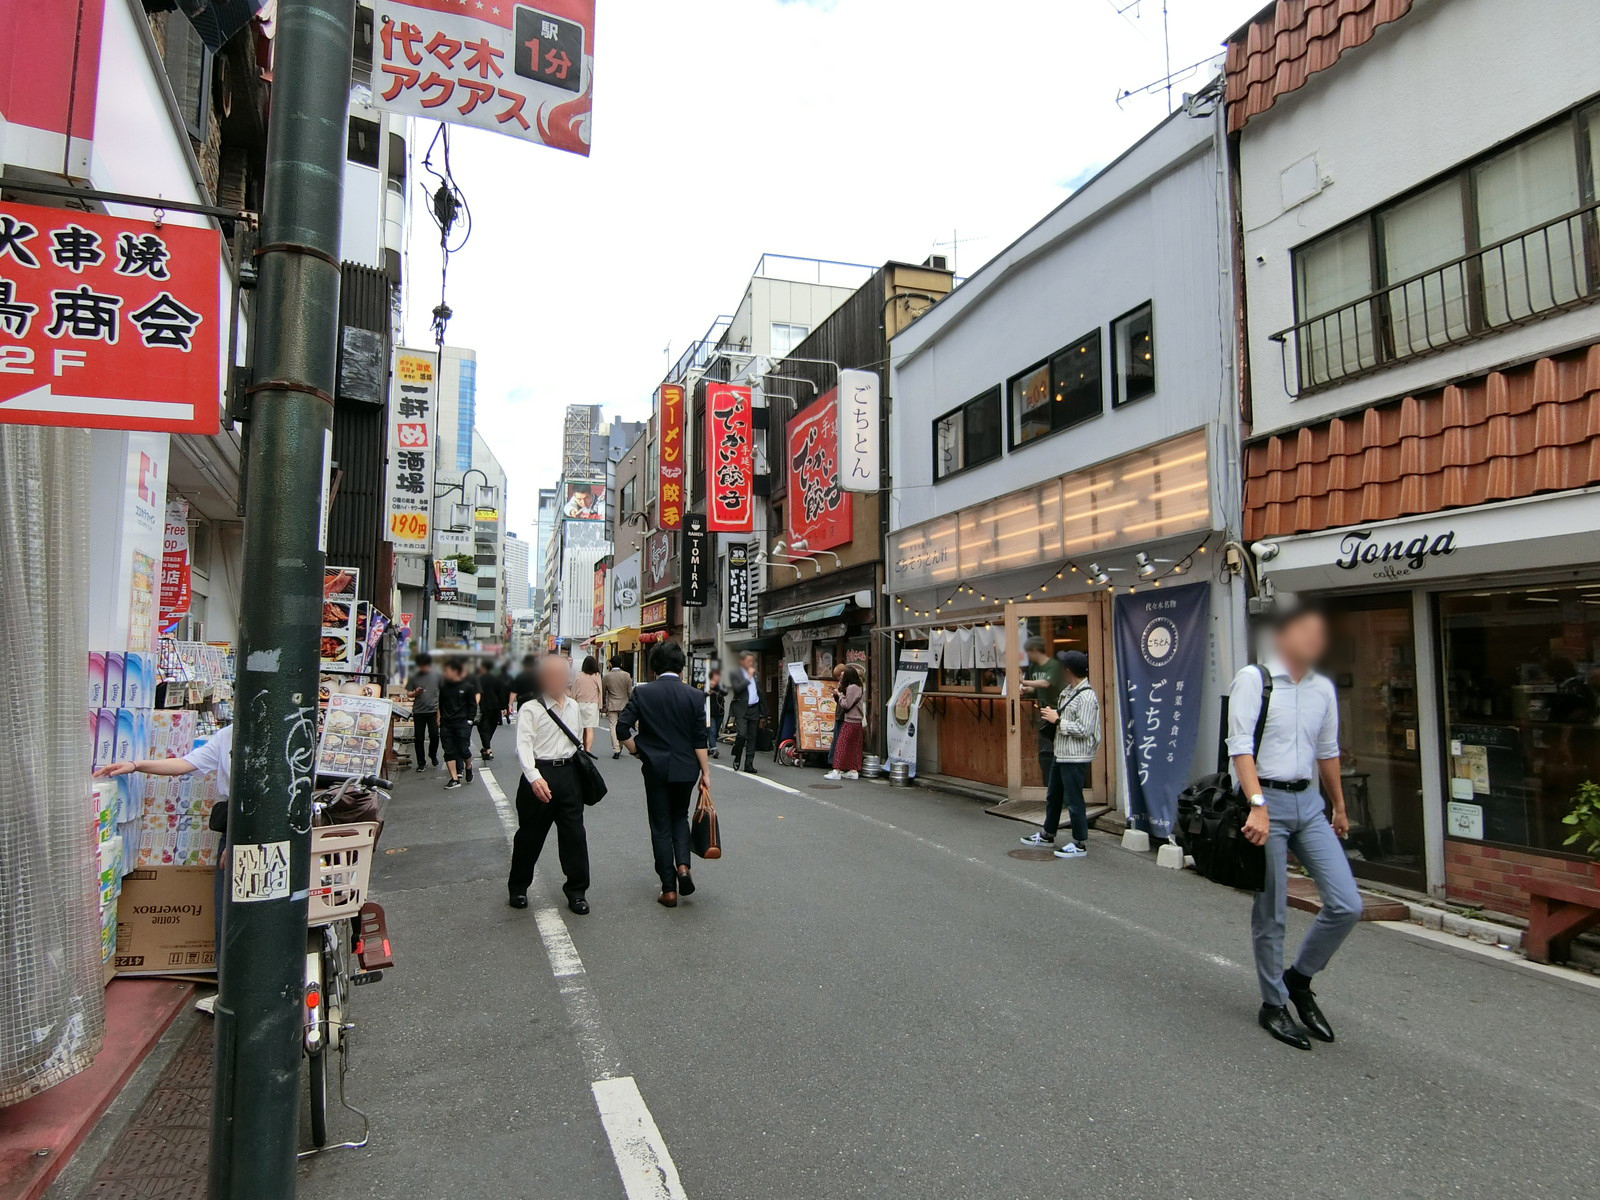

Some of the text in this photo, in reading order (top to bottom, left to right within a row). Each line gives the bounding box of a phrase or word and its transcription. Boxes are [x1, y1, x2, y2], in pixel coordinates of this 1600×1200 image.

[380, 19, 504, 79] 代々木
[540, 20, 559, 41] 駅
[524, 38, 572, 80] 1分
[380, 63, 530, 131] アクアス
[664, 389, 680, 462] ラーメン
[852, 385, 871, 479] ごちとん
[391, 514, 427, 536] 190円
[663, 483, 679, 526] 餃子
[164, 523, 186, 536] Free
[164, 540, 178, 551] op
[1336, 530, 1456, 569] Tonga
[691, 539, 700, 598] TOMIRAI
[1373, 565, 1411, 580] coffee
[1145, 600, 1177, 611] 代々木名物
[1147, 639, 1171, 648] ごちとん
[1138, 678, 1167, 786] ごちそう
[1166, 681, 1184, 762] 野菜を食べる
